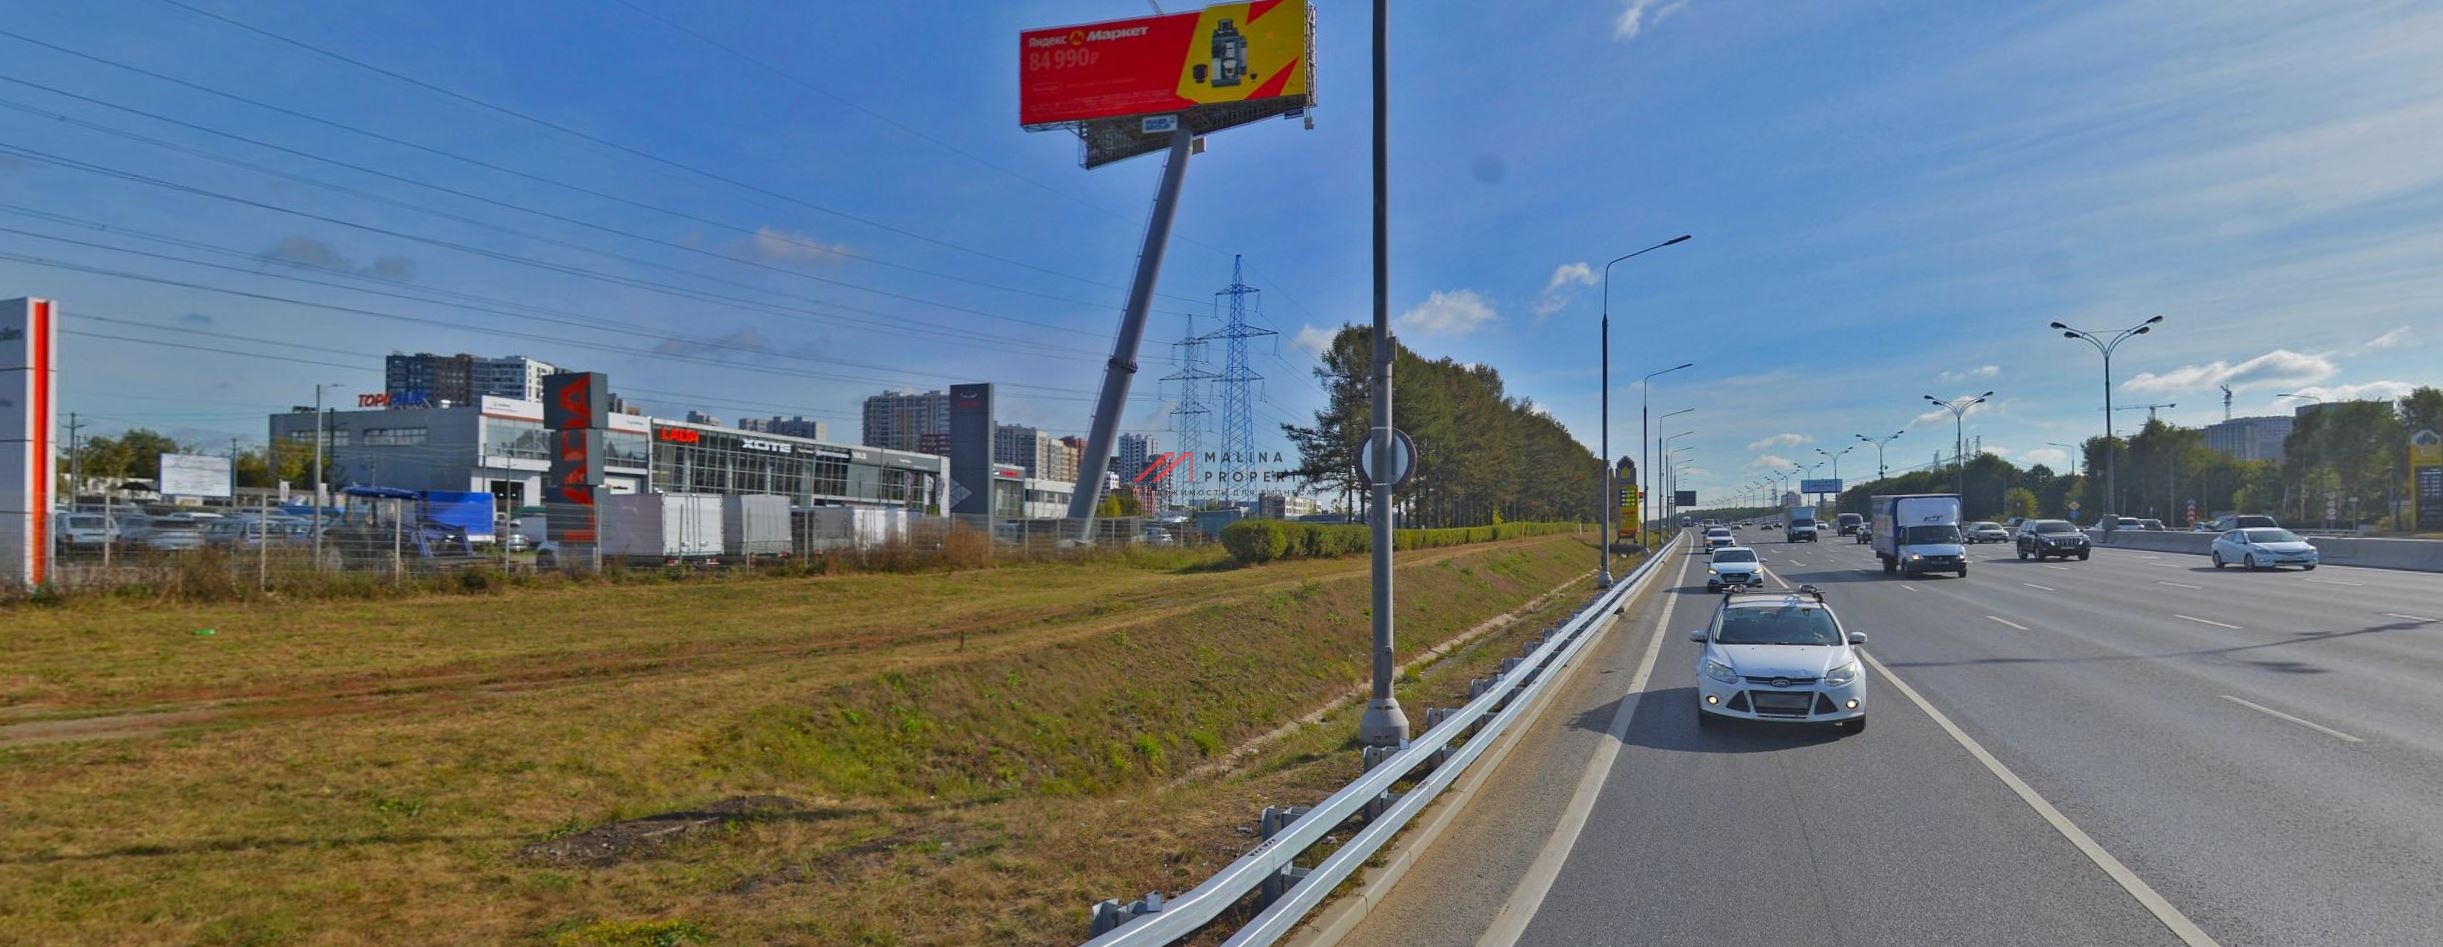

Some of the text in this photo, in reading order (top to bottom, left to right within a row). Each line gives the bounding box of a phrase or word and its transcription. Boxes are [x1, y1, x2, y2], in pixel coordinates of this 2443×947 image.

[1028, 26, 1149, 48] Яндекс Маркет
[1028, 52, 1050, 71] 84
[660, 426, 699, 444] LADA
[742, 439, 792, 453] XCITE
[560, 374, 594, 542] LADA
